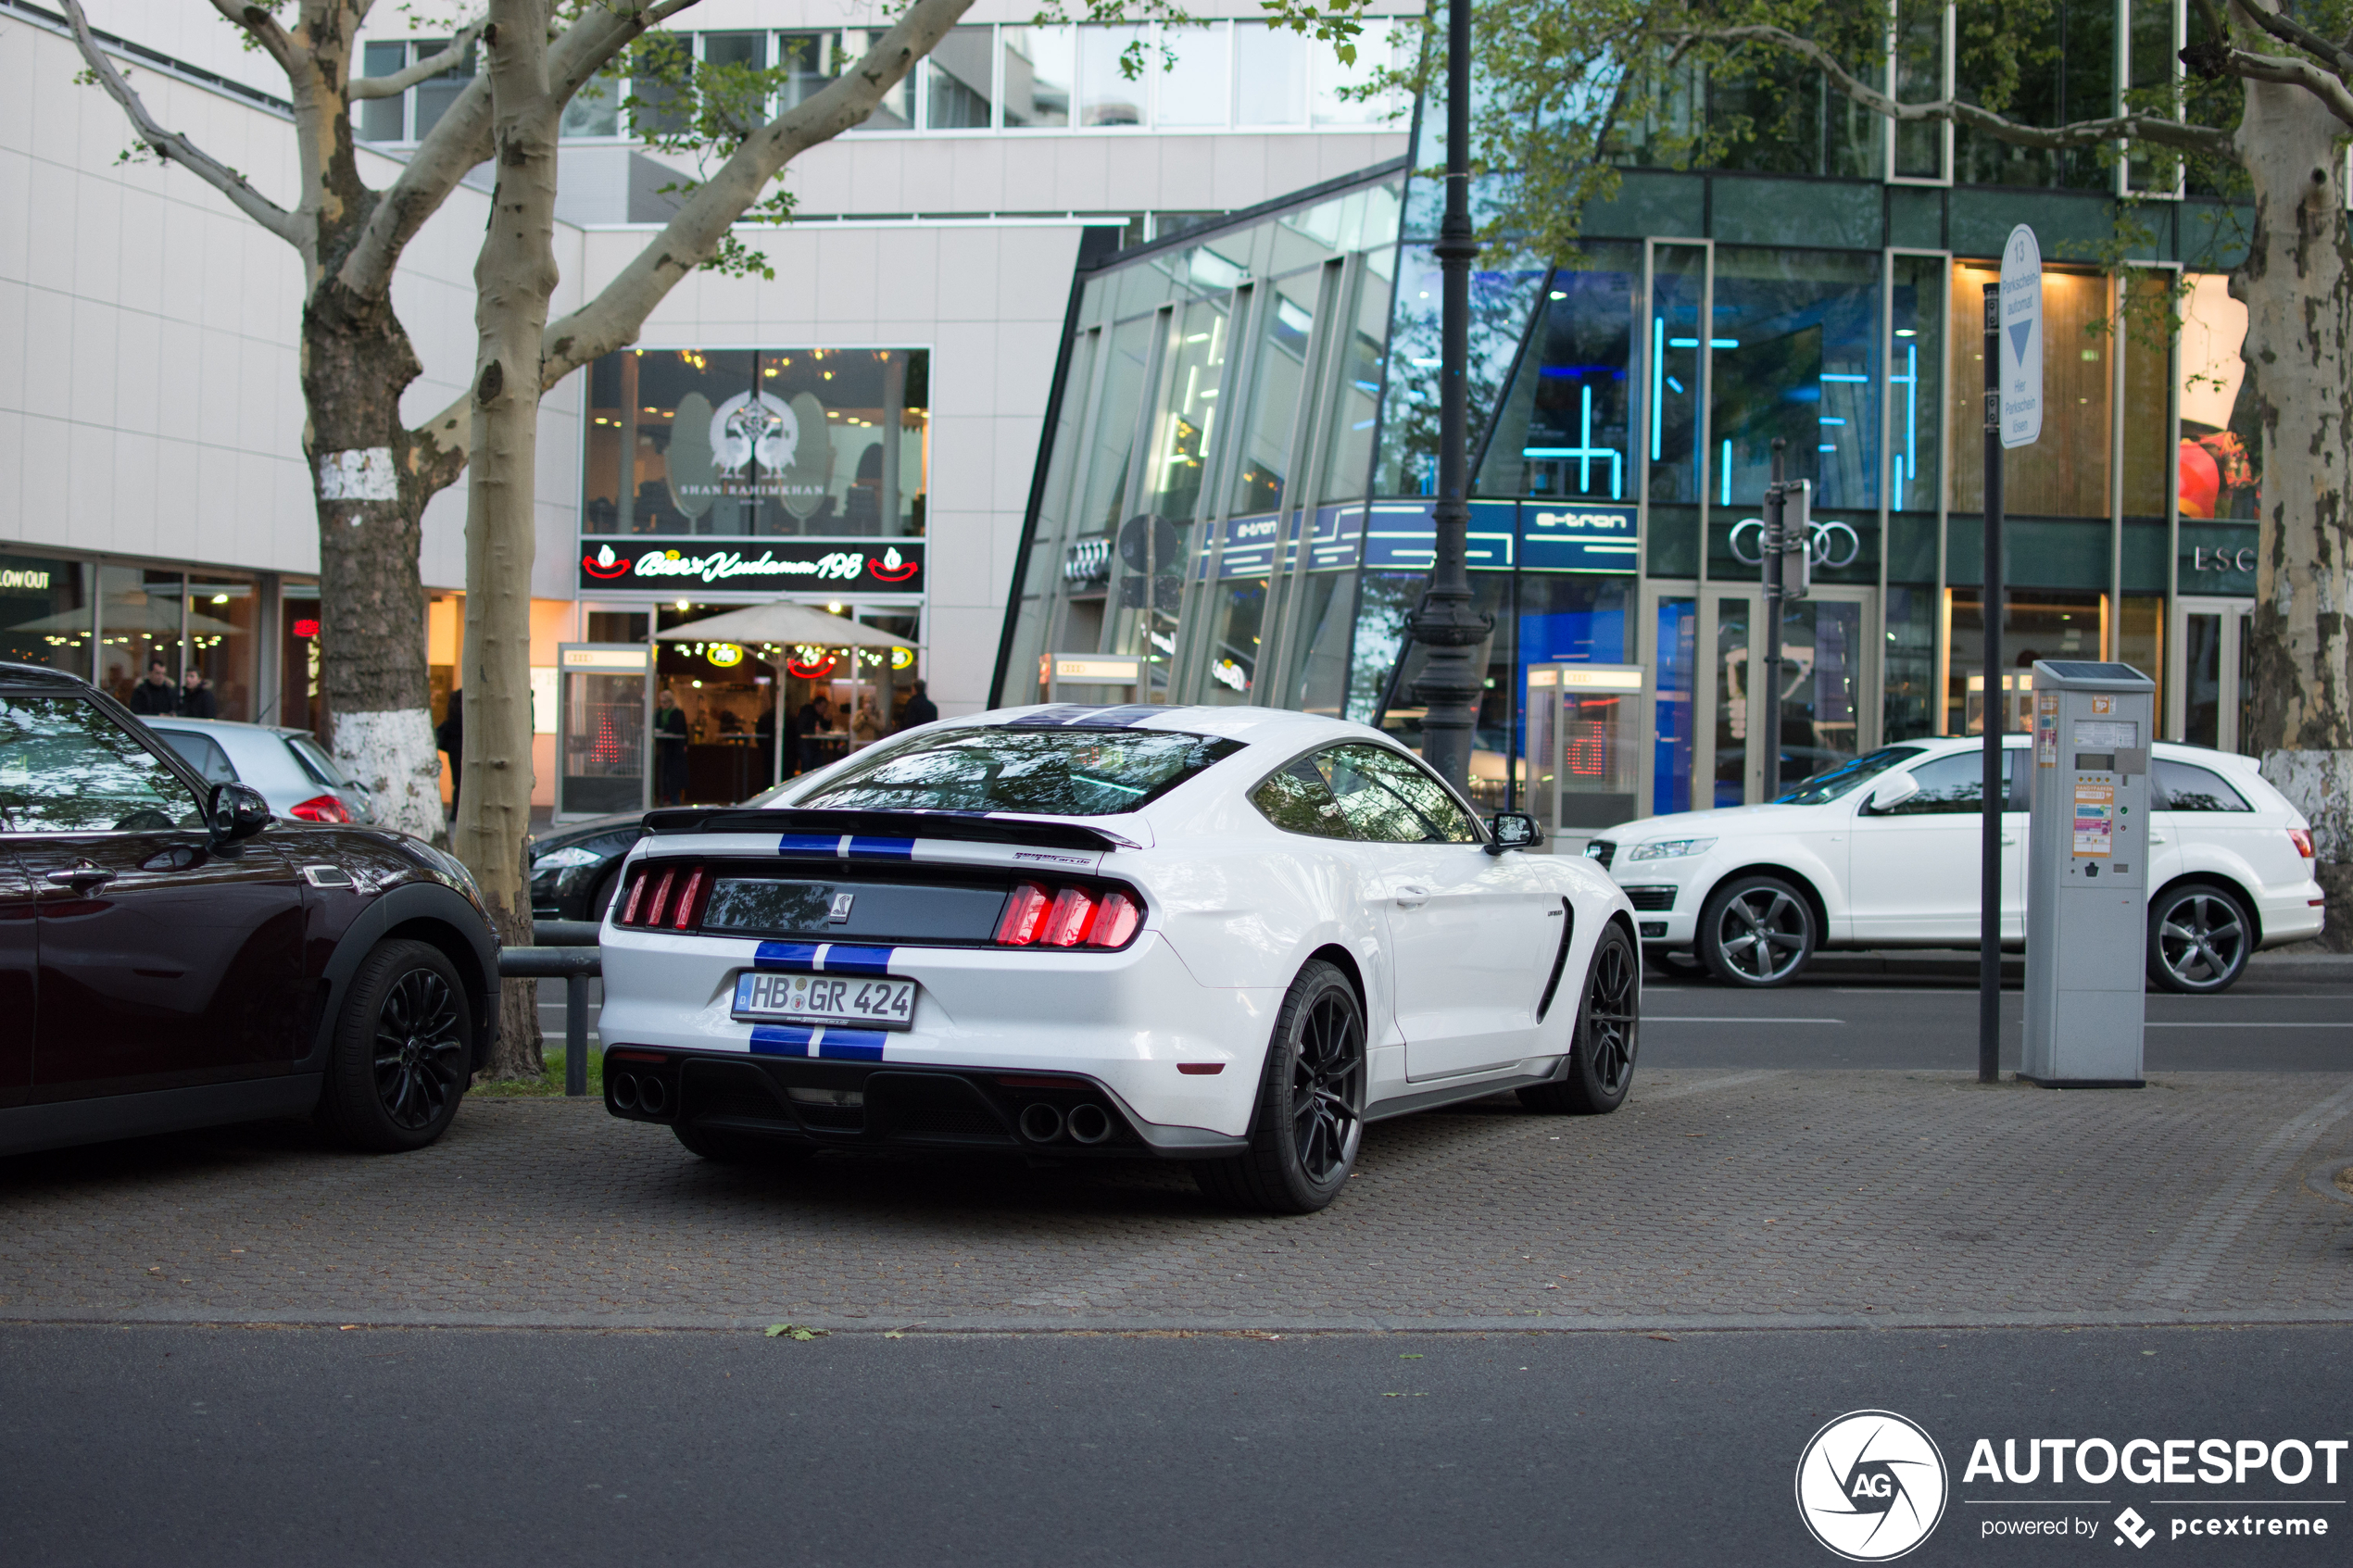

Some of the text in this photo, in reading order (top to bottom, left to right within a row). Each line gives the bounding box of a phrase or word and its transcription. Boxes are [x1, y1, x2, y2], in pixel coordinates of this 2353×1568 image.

[2014, 241, 2025, 264] 13
[2002, 269, 2039, 295] Parkschein-
[2007, 292, 2033, 316] automat
[2014, 379, 2026, 394] Hier
[2005, 395, 2036, 416] Parkschein
[680, 484, 824, 496] SHAN RAHIMKHAN
[1536, 512, 1627, 529] e-tron
[2195, 546, 2255, 572] ESC
[24, 570, 50, 590] OUT
[739, 996, 747, 1005] D
[751, 976, 910, 1016] HB GR 424
